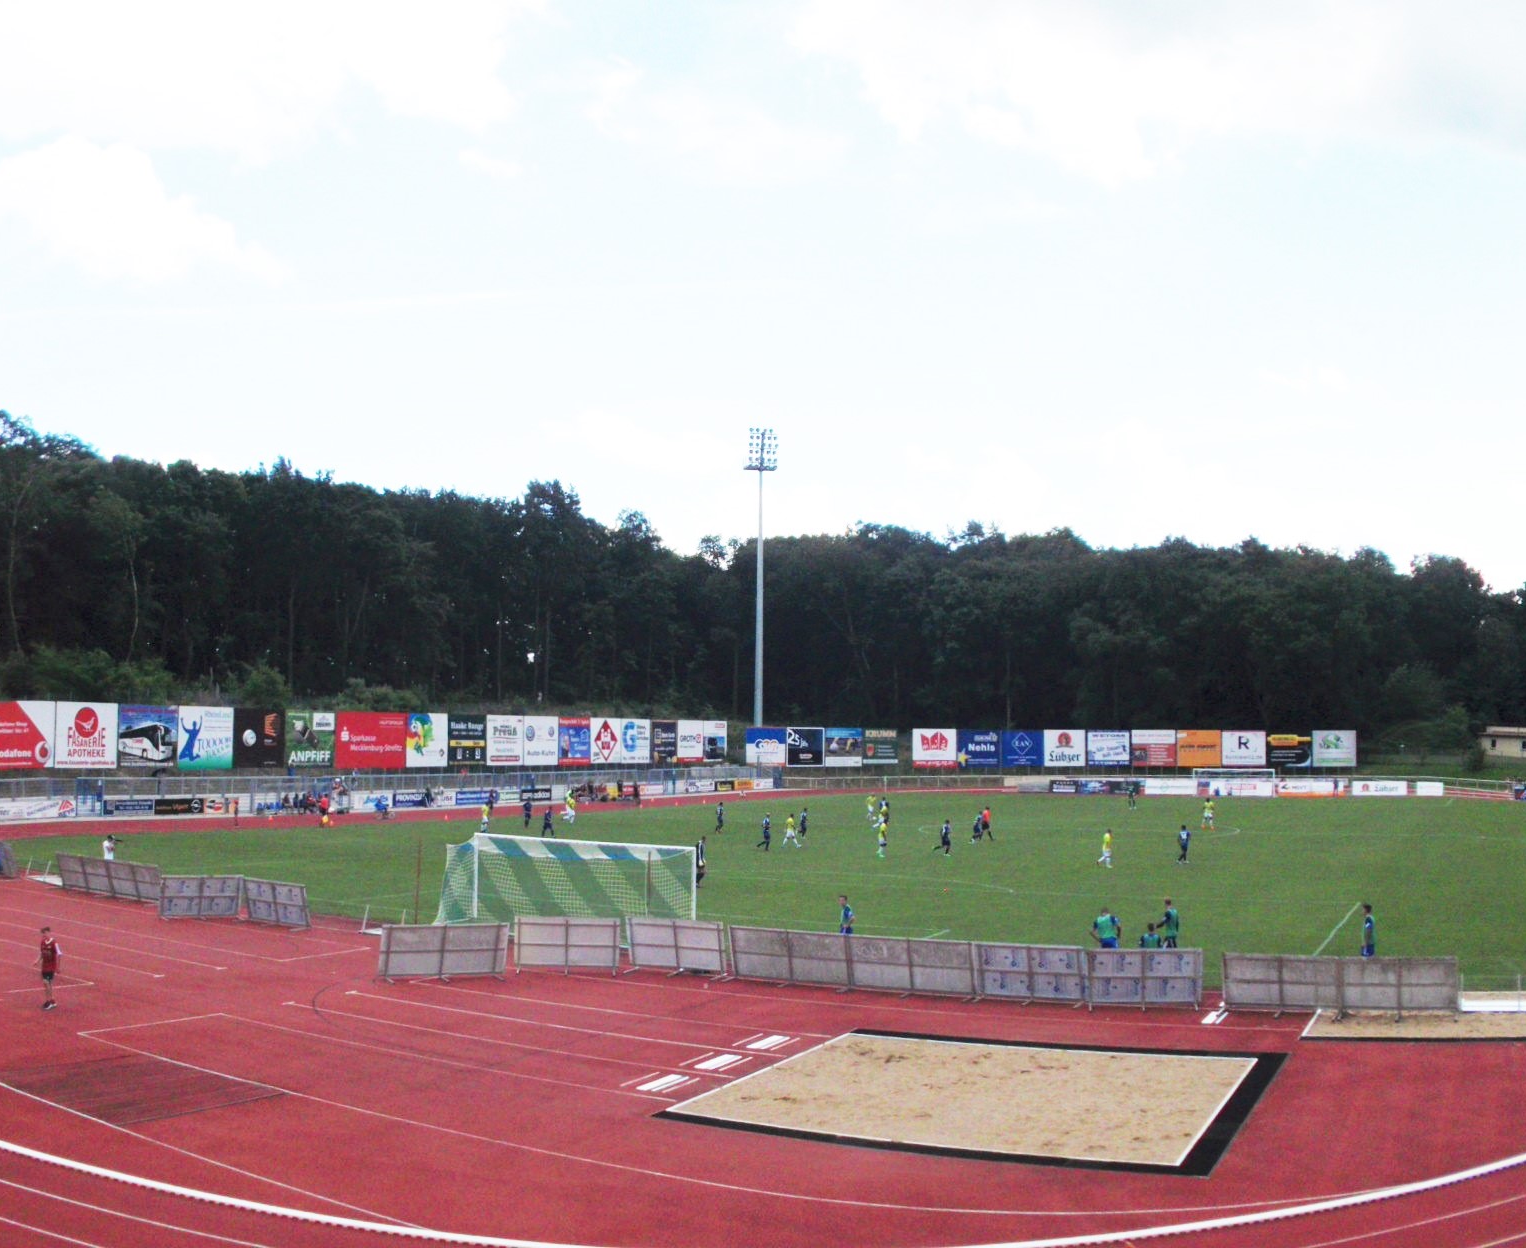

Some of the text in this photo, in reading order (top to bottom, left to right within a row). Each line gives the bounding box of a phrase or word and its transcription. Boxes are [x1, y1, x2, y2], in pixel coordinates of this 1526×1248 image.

[67, 727, 106, 748] FASANERIE
[350, 734, 376, 743] Sparkasse
[968, 743, 996, 751] Nehls
[67, 749, 106, 758] APOTHEKE
[290, 751, 331, 762] ANPFIFF
